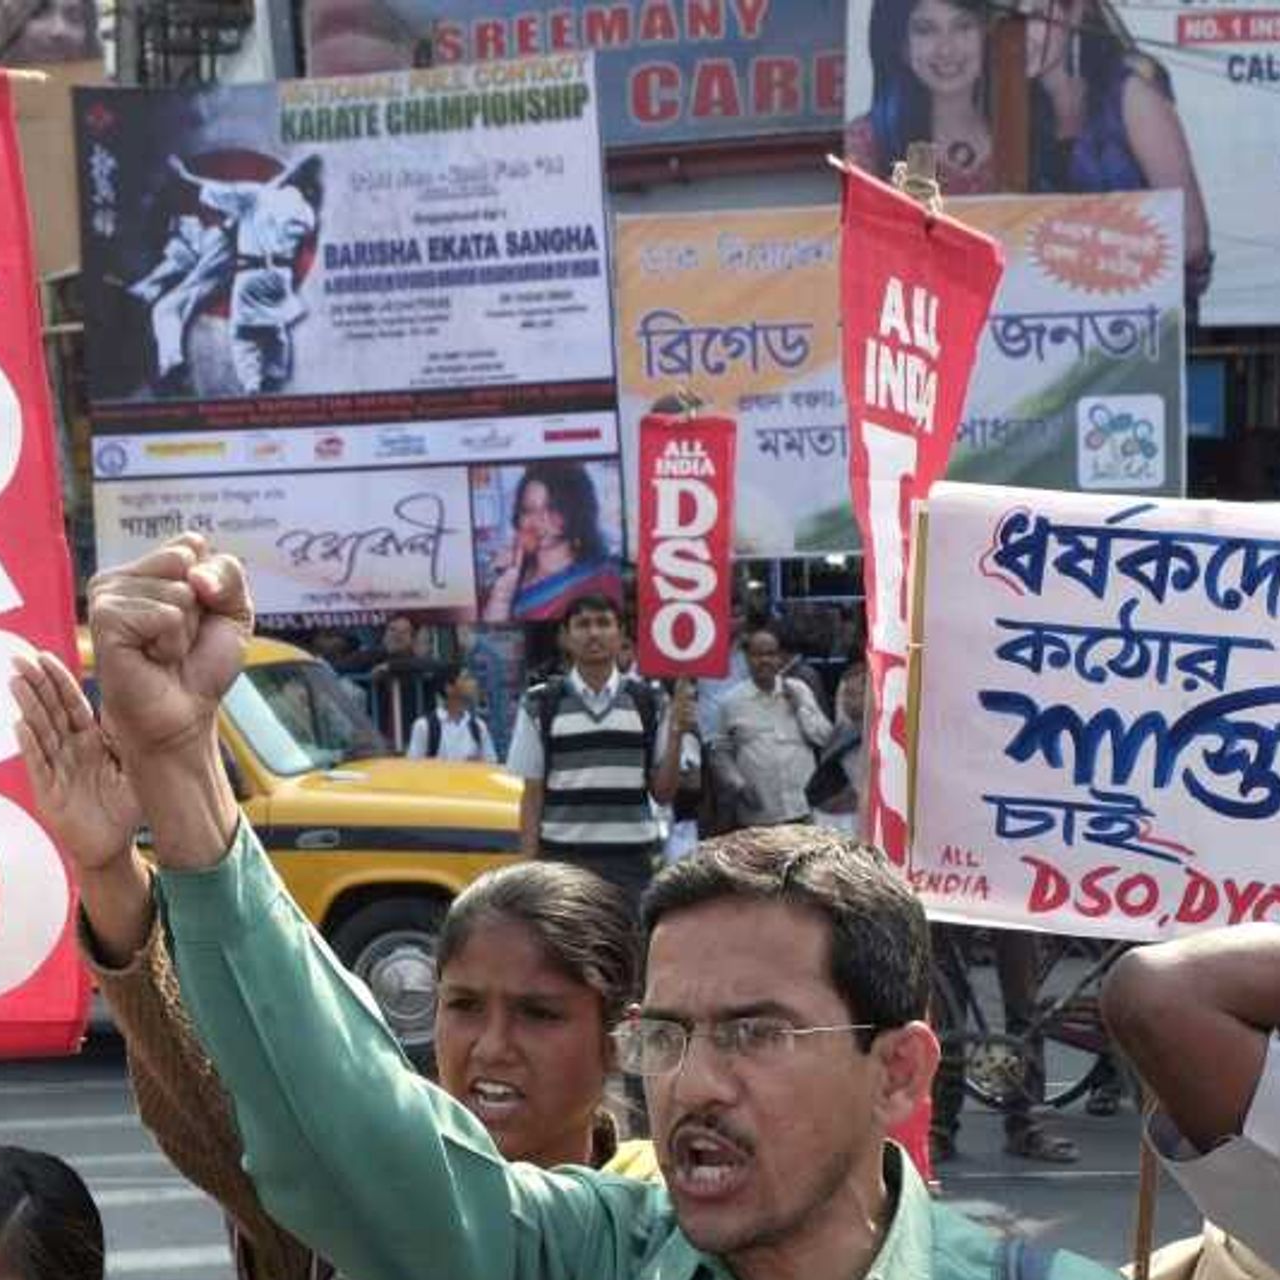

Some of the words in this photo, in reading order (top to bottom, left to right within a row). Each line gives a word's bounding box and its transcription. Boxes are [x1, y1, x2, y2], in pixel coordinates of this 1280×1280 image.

[436, 0, 770, 62] SREEMANY
[281, 103, 380, 143] KARATE
[386, 82, 590, 136] CHAMPIONSHIP
[630, 52, 846, 126] CARE
[324, 238, 421, 270] BARISHA
[428, 231, 500, 262] EKATA
[506, 224, 599, 257] SANGHA
[638, 310, 813, 378] ব্রিগেড
[988, 303, 1160, 362] জনতা
[654, 458, 716, 477] INDIA
[664, 440, 708, 457] ALL
[755, 424, 848, 460] মমতা
[994, 598, 1275, 692] কঠোর
[940, 844, 981, 867] ALL
[980, 787, 1183, 865] চাই
